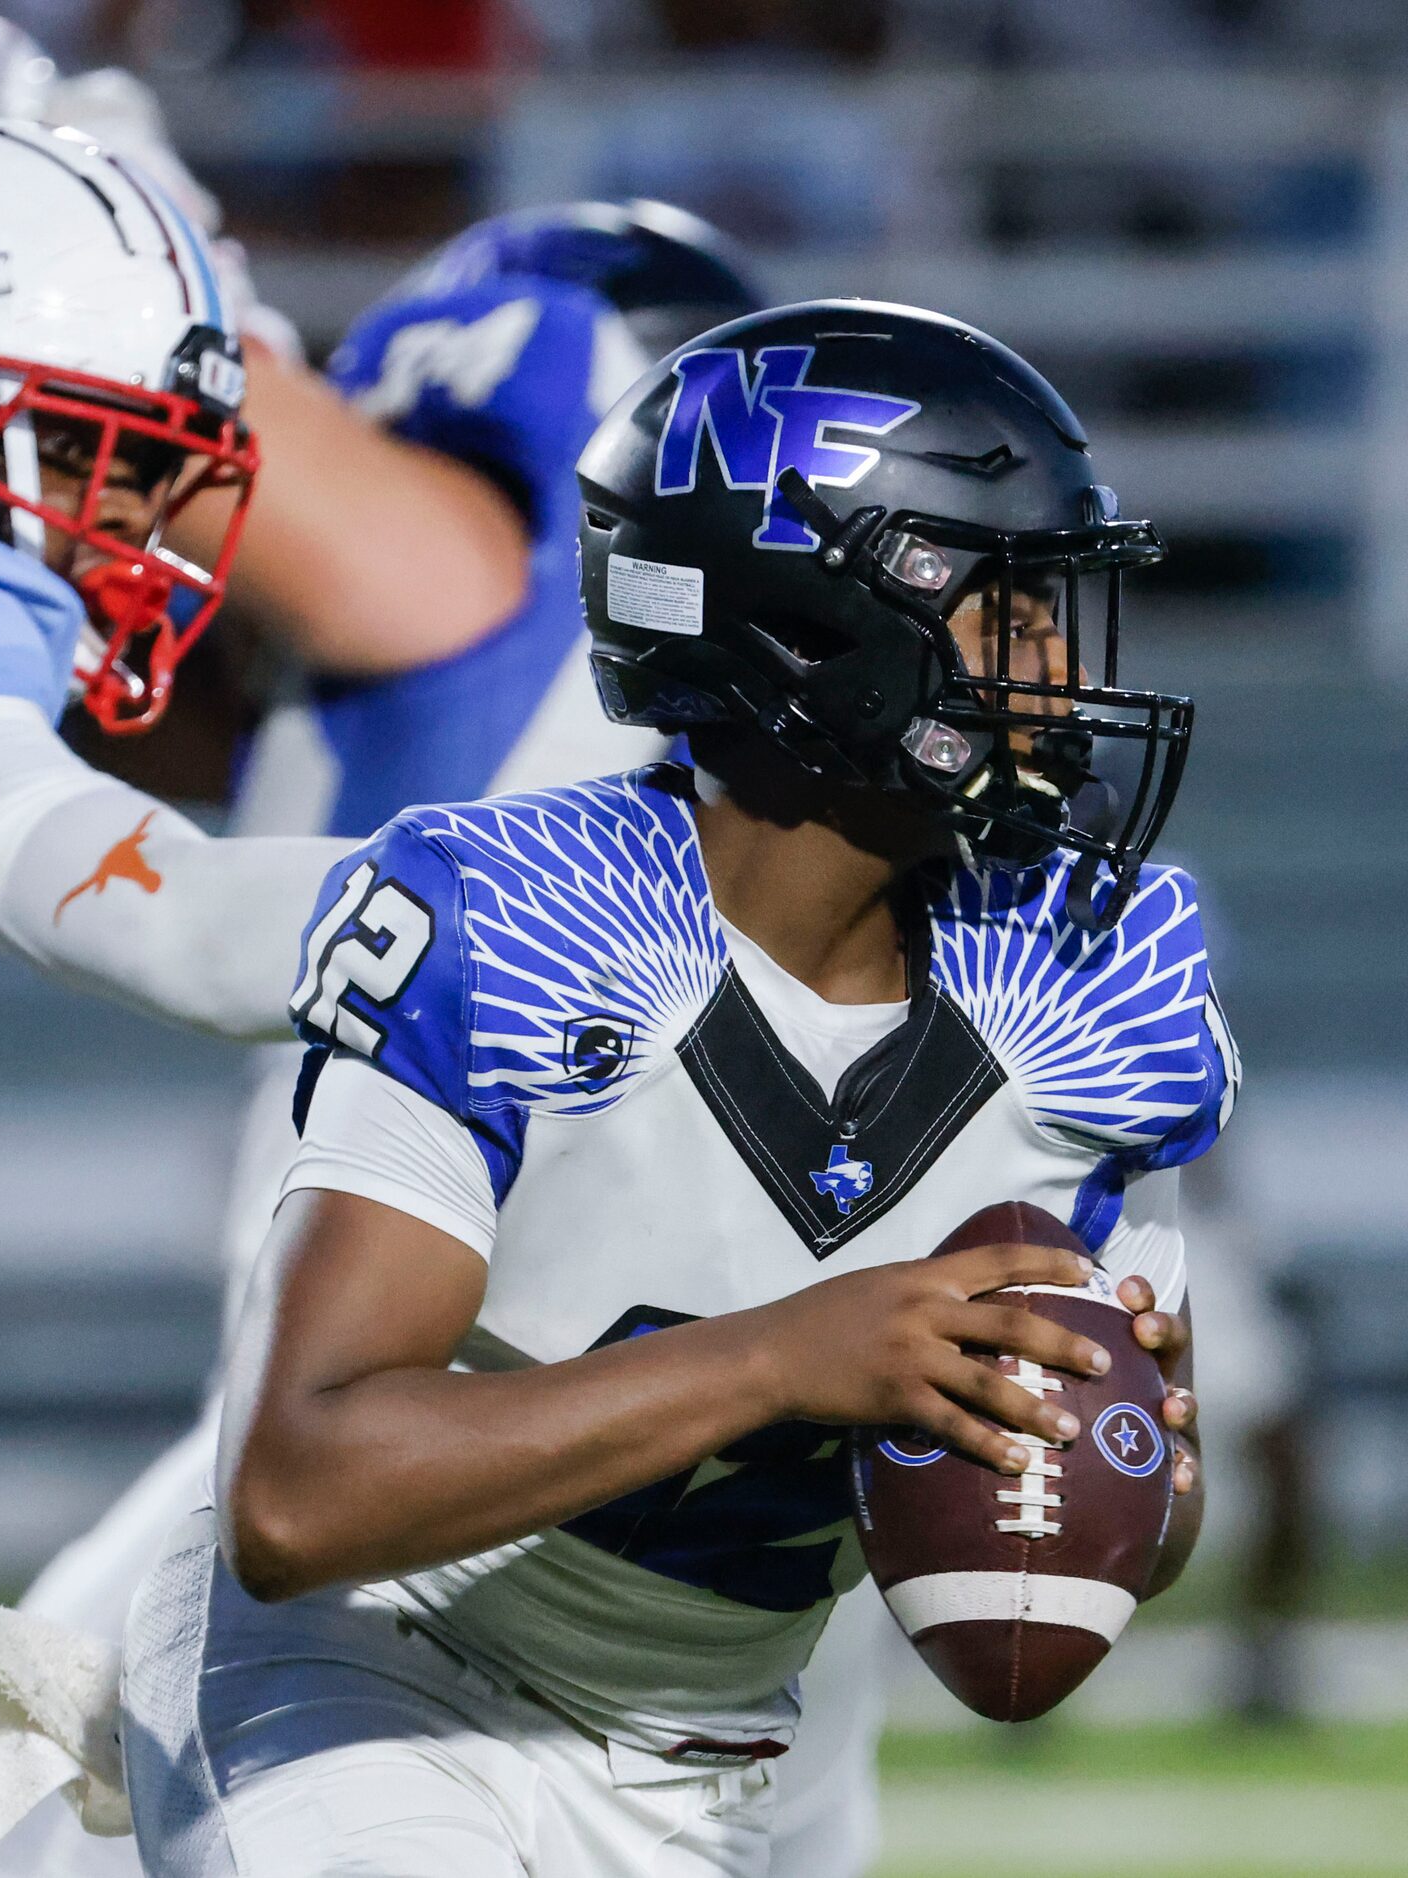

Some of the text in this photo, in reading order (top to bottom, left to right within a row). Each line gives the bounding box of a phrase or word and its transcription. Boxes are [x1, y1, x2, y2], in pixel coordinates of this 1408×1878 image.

[654, 345, 922, 553] NF
[631, 561, 668, 575] WARNING
[288, 858, 435, 1060] 12
